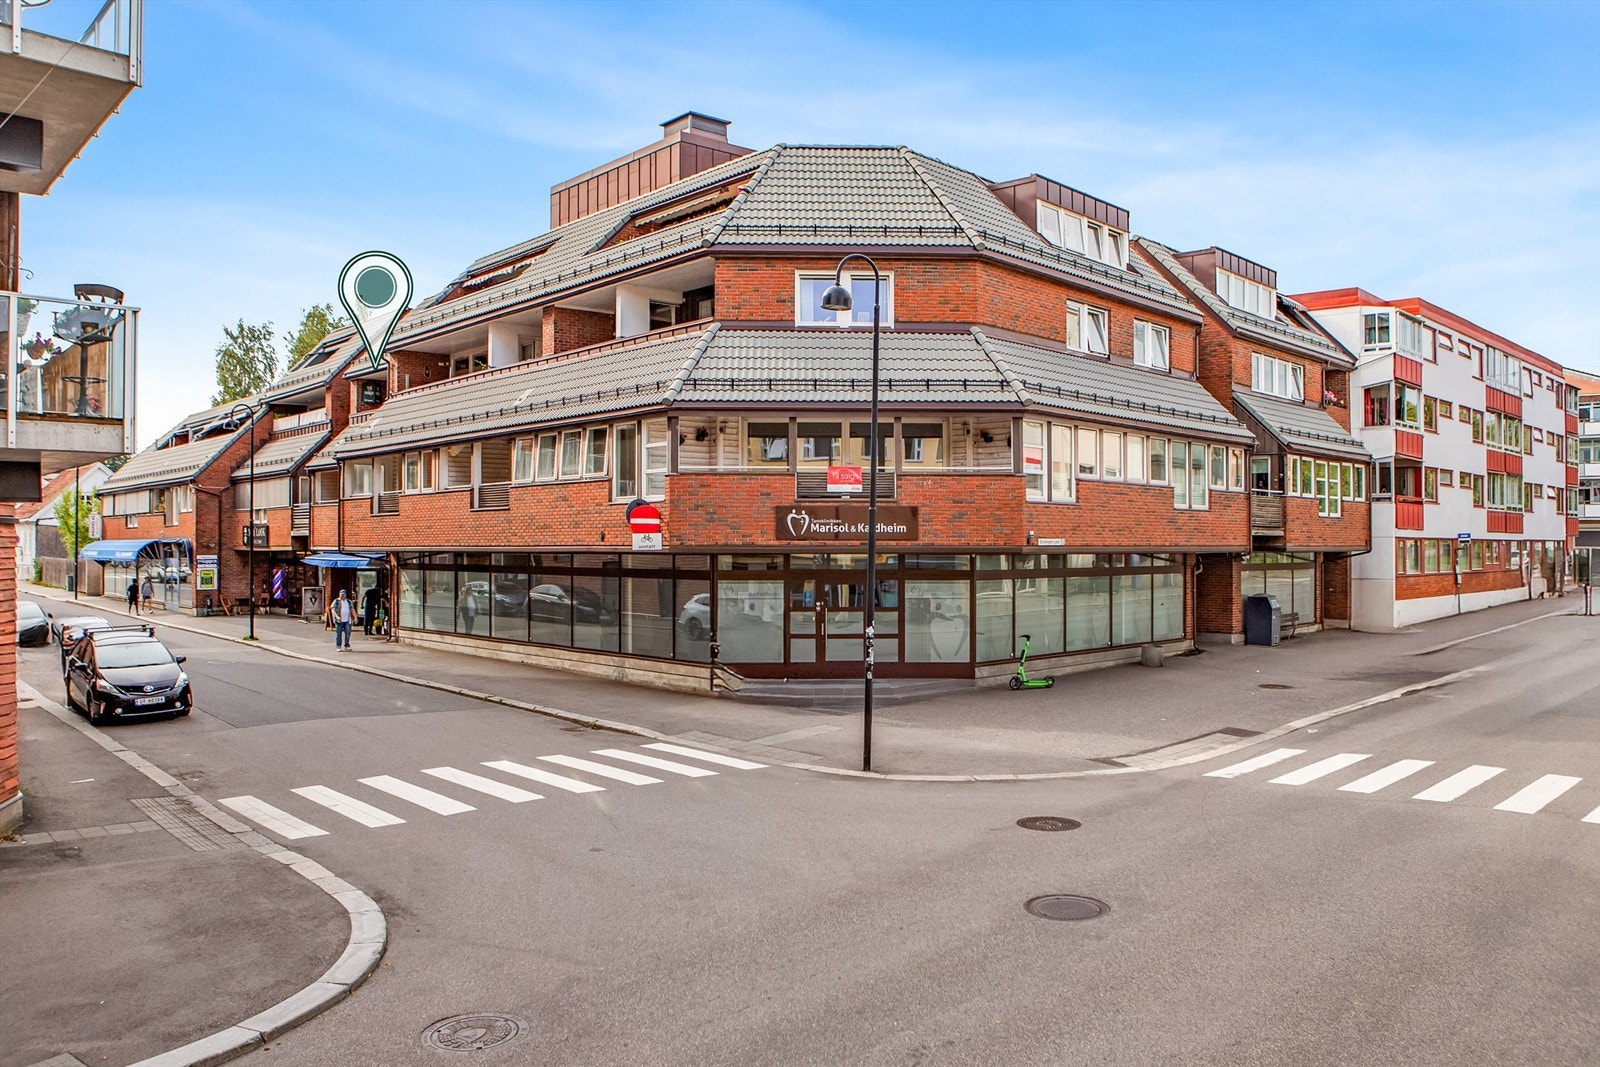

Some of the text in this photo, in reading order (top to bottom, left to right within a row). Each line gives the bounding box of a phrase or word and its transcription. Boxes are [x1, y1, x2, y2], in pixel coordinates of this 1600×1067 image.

[832, 471, 859, 482] Til salgs
[810, 523, 907, 533] Marisol & Kadheim
